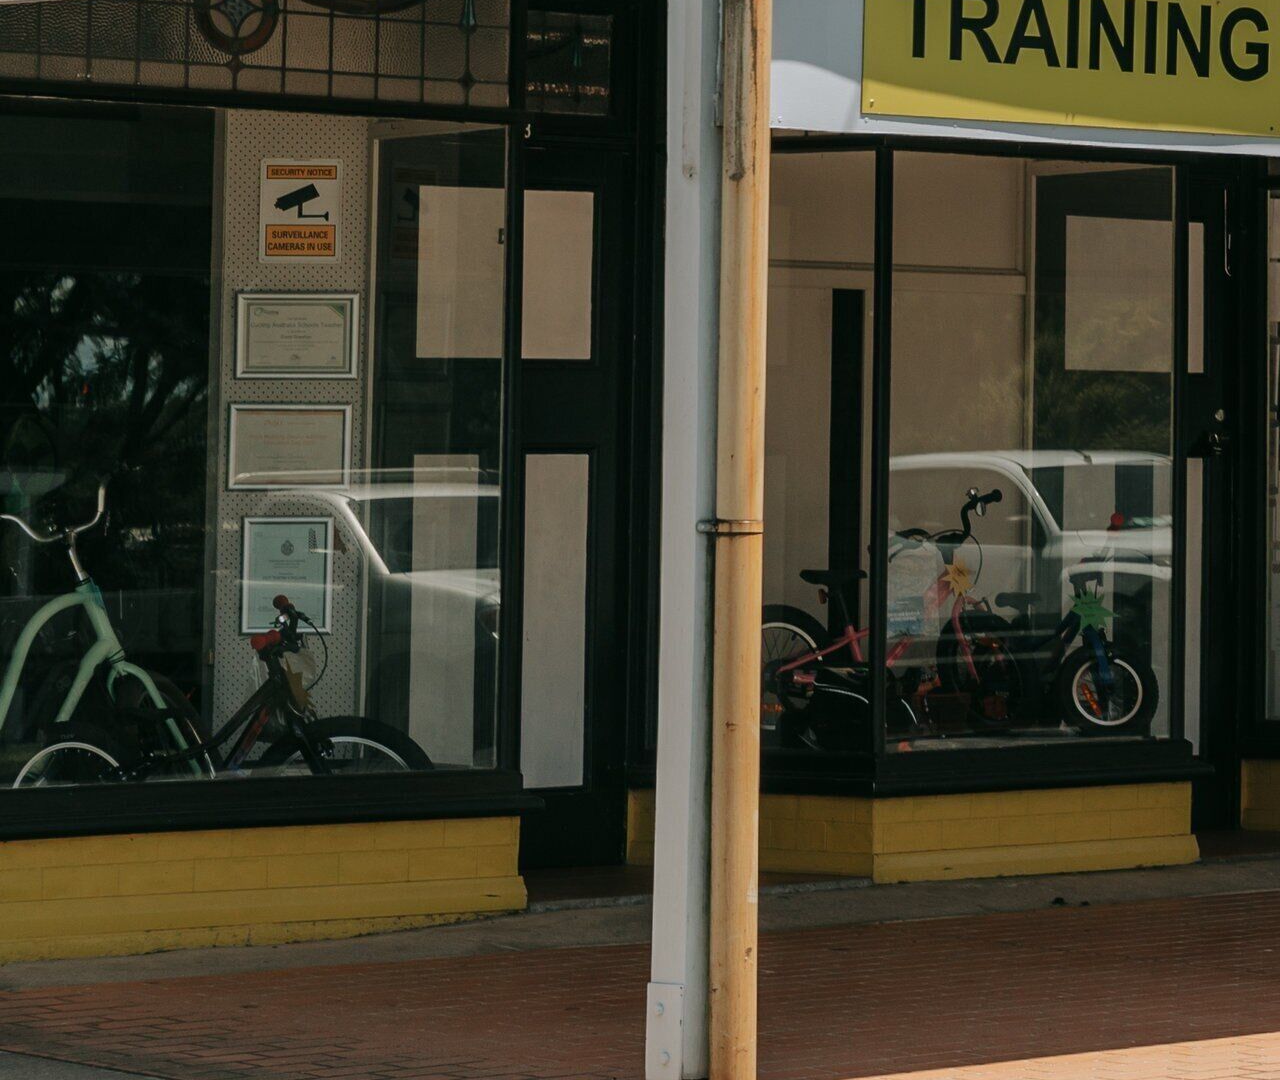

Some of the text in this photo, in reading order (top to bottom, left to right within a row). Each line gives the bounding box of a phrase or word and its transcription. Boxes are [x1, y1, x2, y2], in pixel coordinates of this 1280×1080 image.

[271, 168, 333, 177] SECURITY NOTICE
[272, 230, 329, 240] SURVEILLANCE
[268, 242, 333, 251] CAMERAS IN USE
